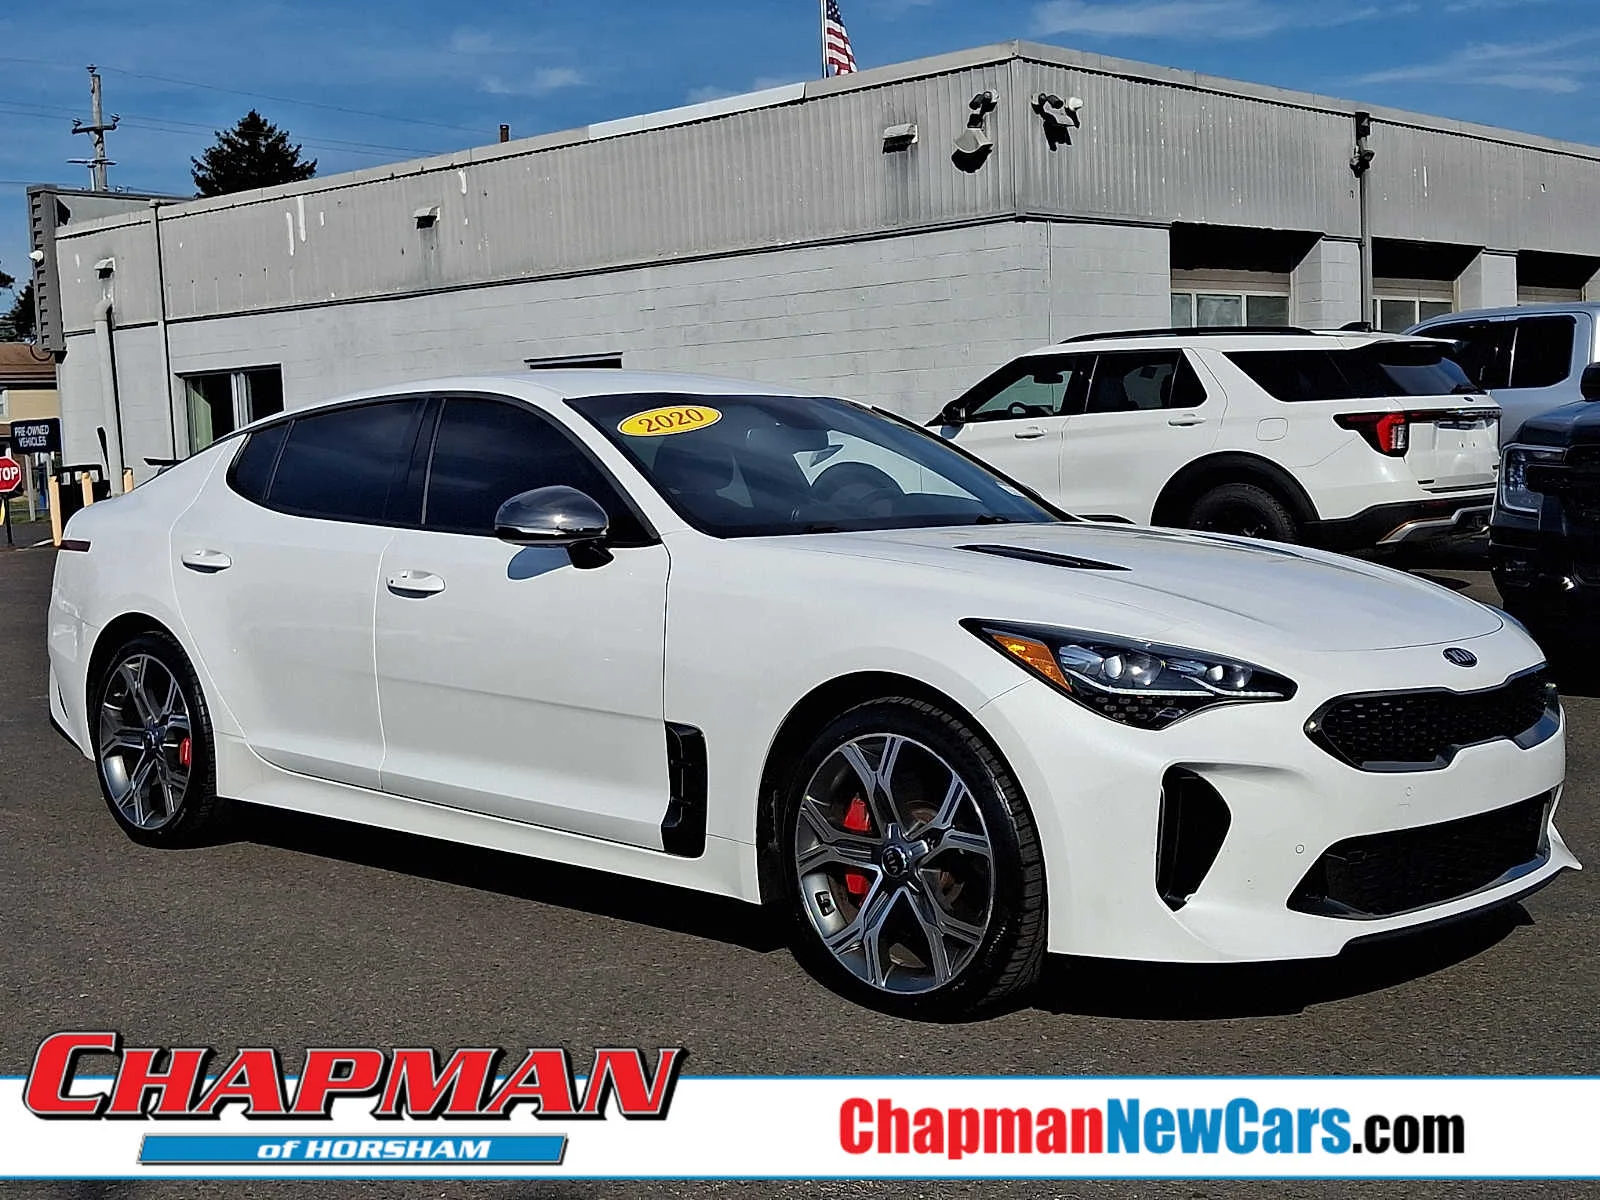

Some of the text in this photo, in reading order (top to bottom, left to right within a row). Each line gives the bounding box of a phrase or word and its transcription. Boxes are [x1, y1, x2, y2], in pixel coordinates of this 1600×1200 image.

[638, 408, 704, 432] 2020
[14, 424, 50, 437] PRE-OWNED
[18, 435, 47, 448] VEHICLES
